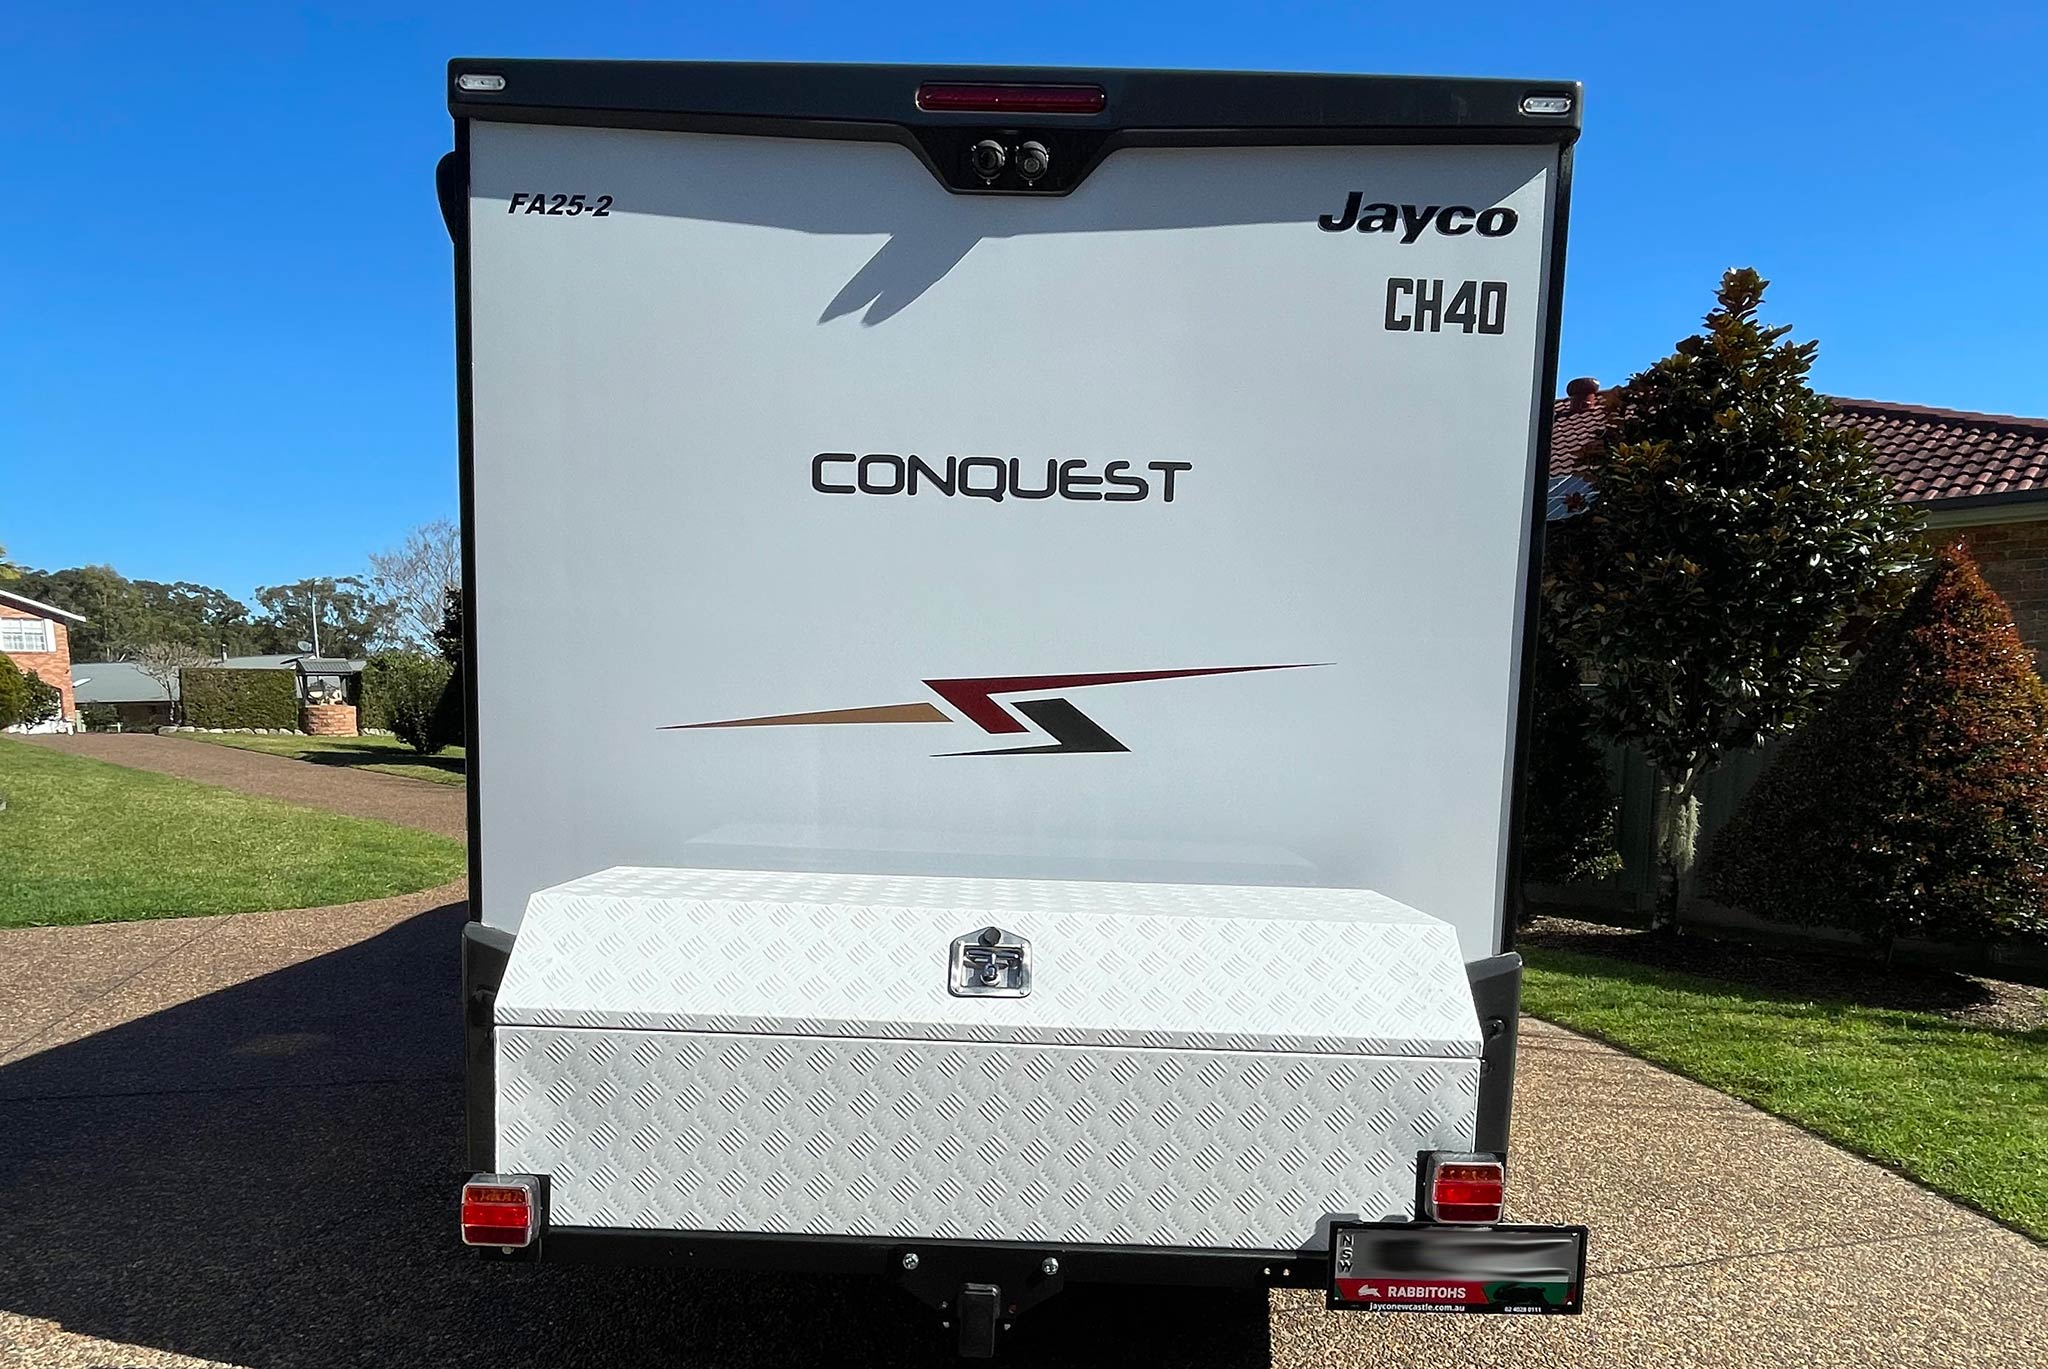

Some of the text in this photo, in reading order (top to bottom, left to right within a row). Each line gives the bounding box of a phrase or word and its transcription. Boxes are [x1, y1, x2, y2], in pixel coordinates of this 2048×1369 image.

[508, 193, 613, 216] FA25-2
[1317, 191, 1519, 244] Jayco
[1385, 277, 1508, 335] CH40
[811, 453, 1193, 502] CONQUEST
[1369, 1302, 1466, 1312] jayconewcastle.com.au
[1388, 1286, 1467, 1299] RABBITOHS
